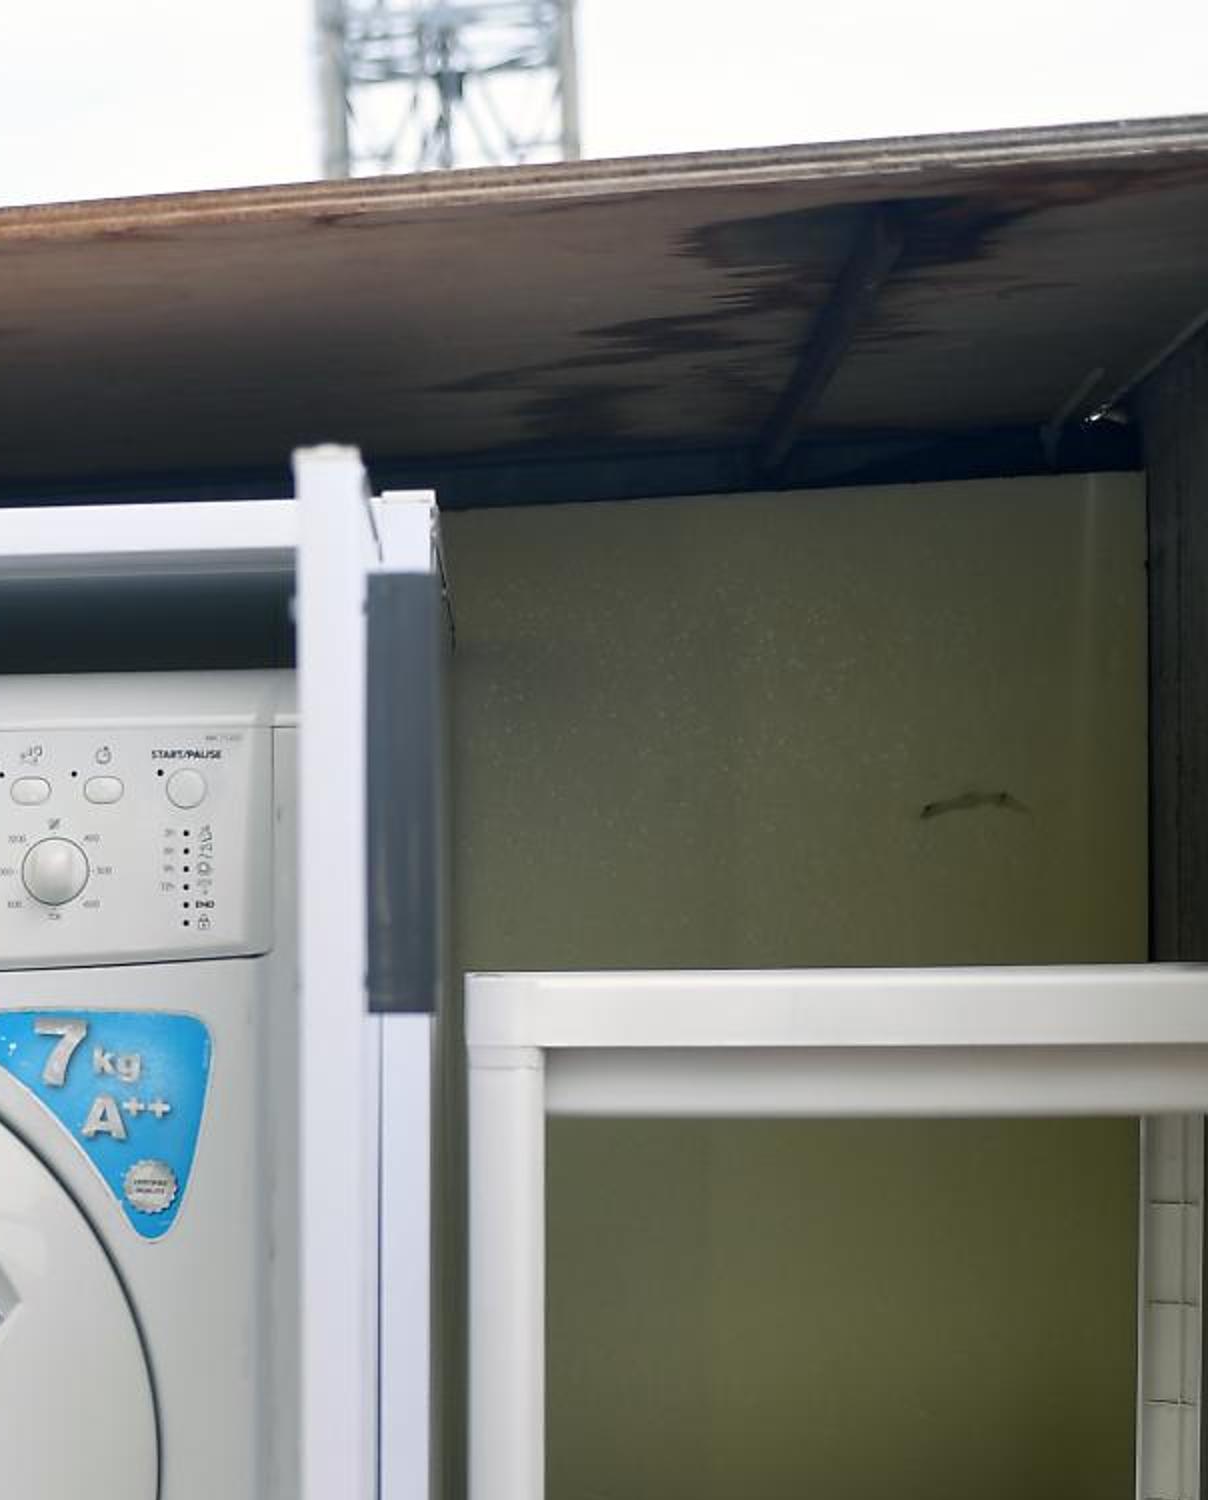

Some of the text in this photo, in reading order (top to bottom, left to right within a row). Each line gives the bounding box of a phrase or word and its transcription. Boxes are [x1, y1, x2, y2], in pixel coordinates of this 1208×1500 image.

[151, 750, 222, 759] START/PAUSE
[34, 1018, 142, 1088] 7 kg
[81, 1095, 172, 1141] A++
